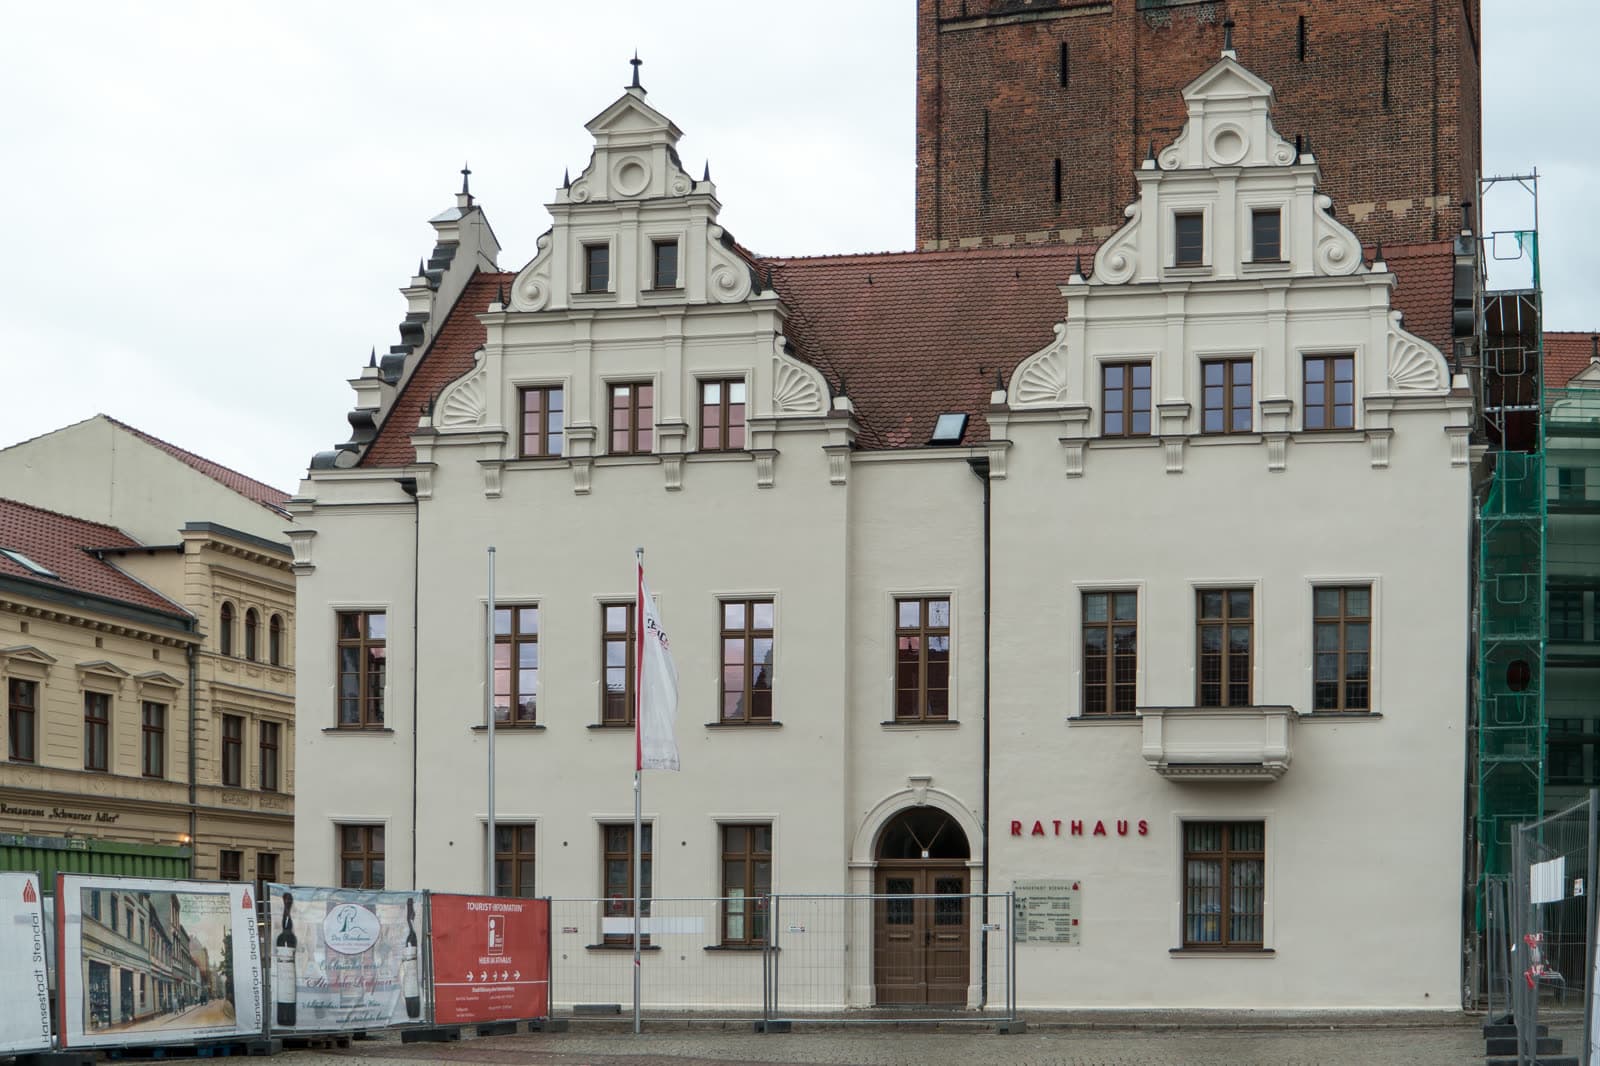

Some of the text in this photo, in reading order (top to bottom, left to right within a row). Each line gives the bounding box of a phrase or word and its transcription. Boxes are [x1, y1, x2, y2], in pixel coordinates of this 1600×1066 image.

[1, 803, 44, 817] Restaurant
[1011, 820, 1149, 836] RATHAUS
[31, 912, 49, 1043] Hansestadt Stendal
[247, 917, 262, 1030] Hansestadt Stendal
